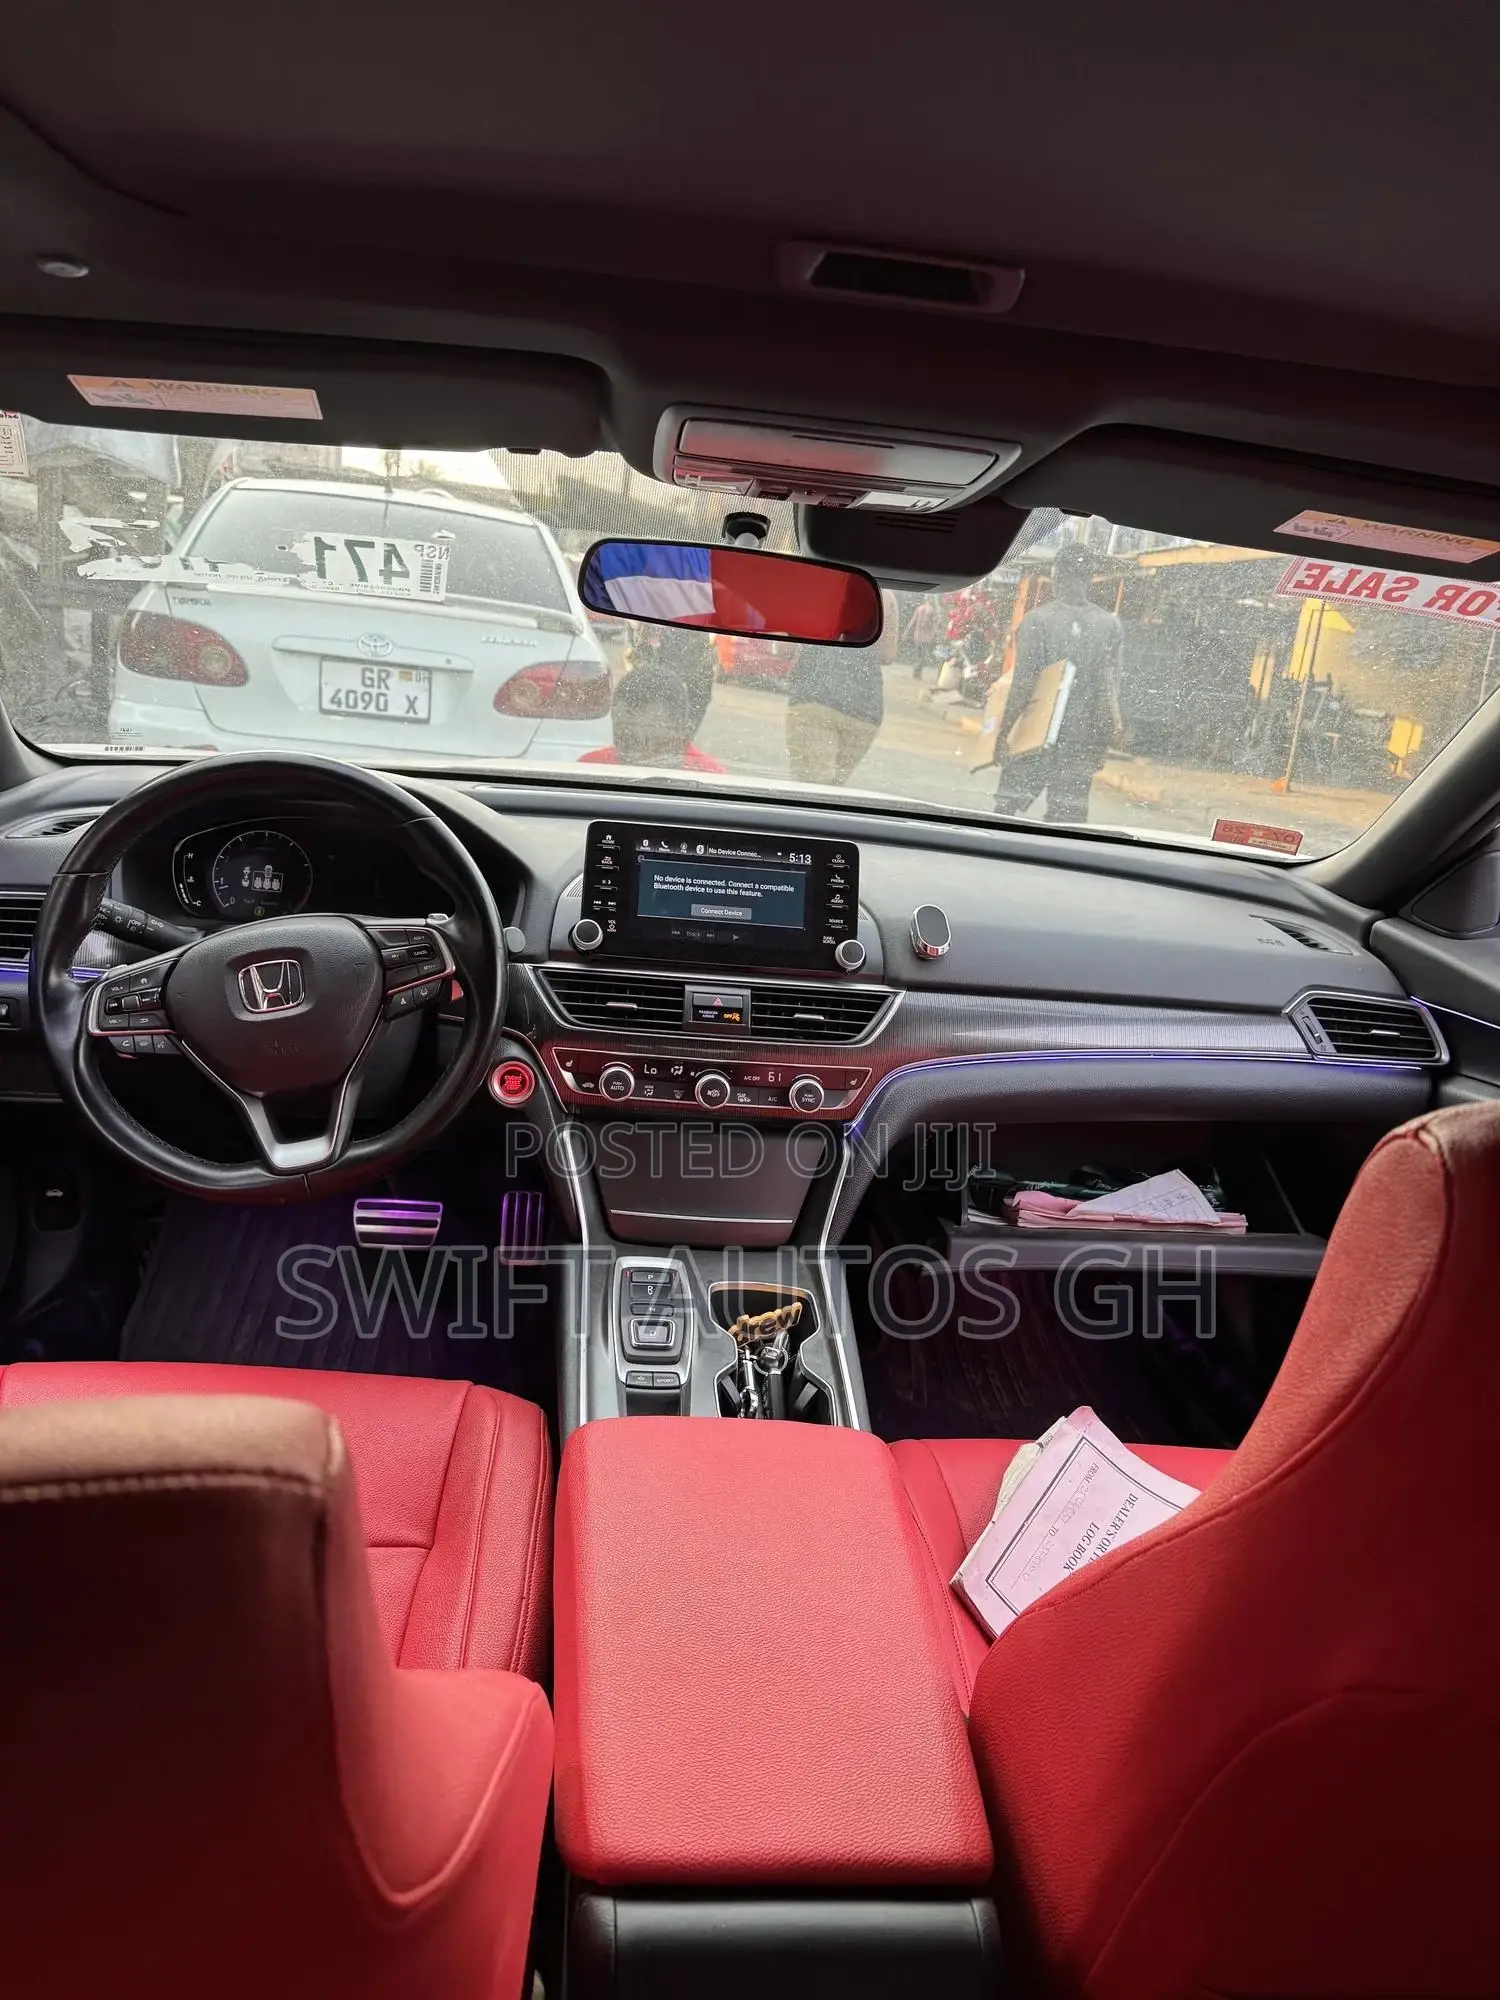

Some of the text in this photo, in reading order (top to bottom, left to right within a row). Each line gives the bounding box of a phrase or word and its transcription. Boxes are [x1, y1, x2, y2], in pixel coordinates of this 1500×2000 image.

[149, 381, 281, 397] WARNING
[1362, 523, 1476, 545] WARNING
[361, 667, 390, 690] GR
[329, 688, 418, 716] 4090 X
[789, 853, 811, 864] 5:13
[654, 882, 684, 891] Bluetooth
[685, 885, 705, 893] device
[739, 889, 763, 898] feature.
[693, 878, 727, 886] connected.
[728, 881, 754, 889] Connect
[760, 884, 794, 893] compatible
[700, 907, 724, 915] Connect
[1048, 1462, 1099, 1537] FROM TO
[1081, 1522, 1100, 1546] LOG
[1096, 1493, 1139, 1553] DEALER'S OR
[1063, 1543, 1087, 1573] BOOK
